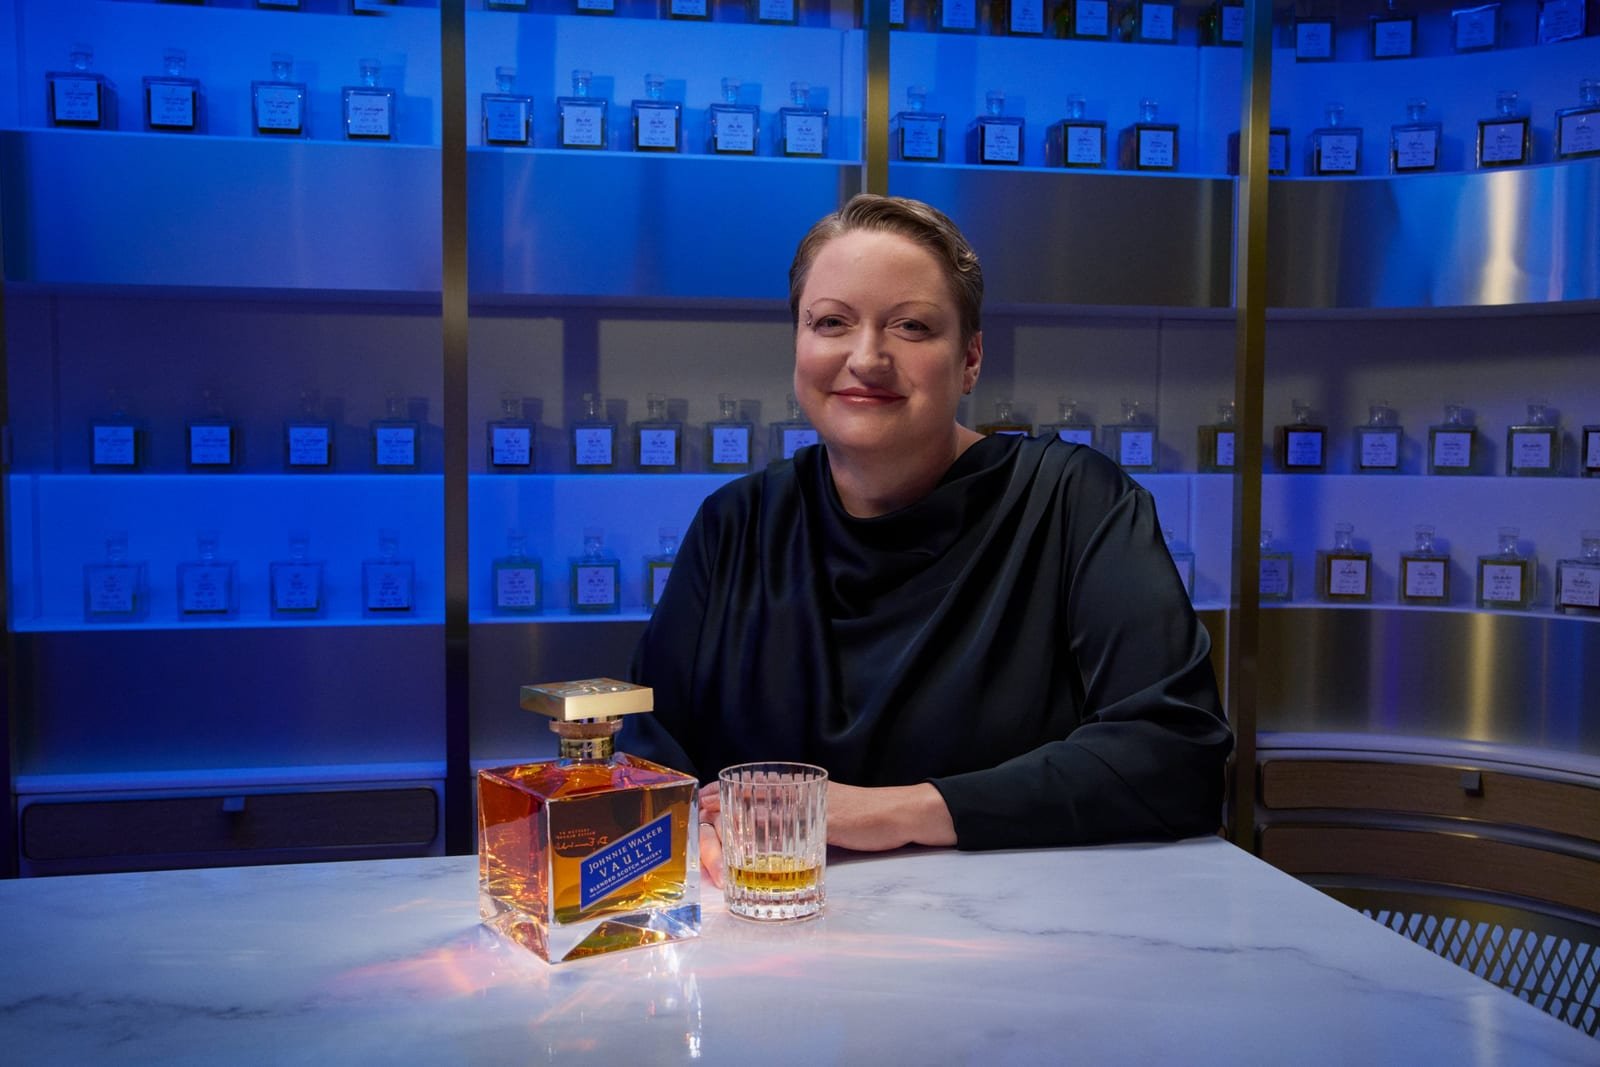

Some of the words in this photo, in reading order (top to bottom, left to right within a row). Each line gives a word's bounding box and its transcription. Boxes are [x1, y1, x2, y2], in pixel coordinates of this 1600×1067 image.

[588, 845, 627, 874] JOHNNIE
[628, 826, 663, 850] WALKER
[589, 875, 616, 893] BLENDED
[617, 863, 640, 878] SCOTCH
[640, 849, 662, 864] WHISKY
[599, 842, 653, 878] VAULT
